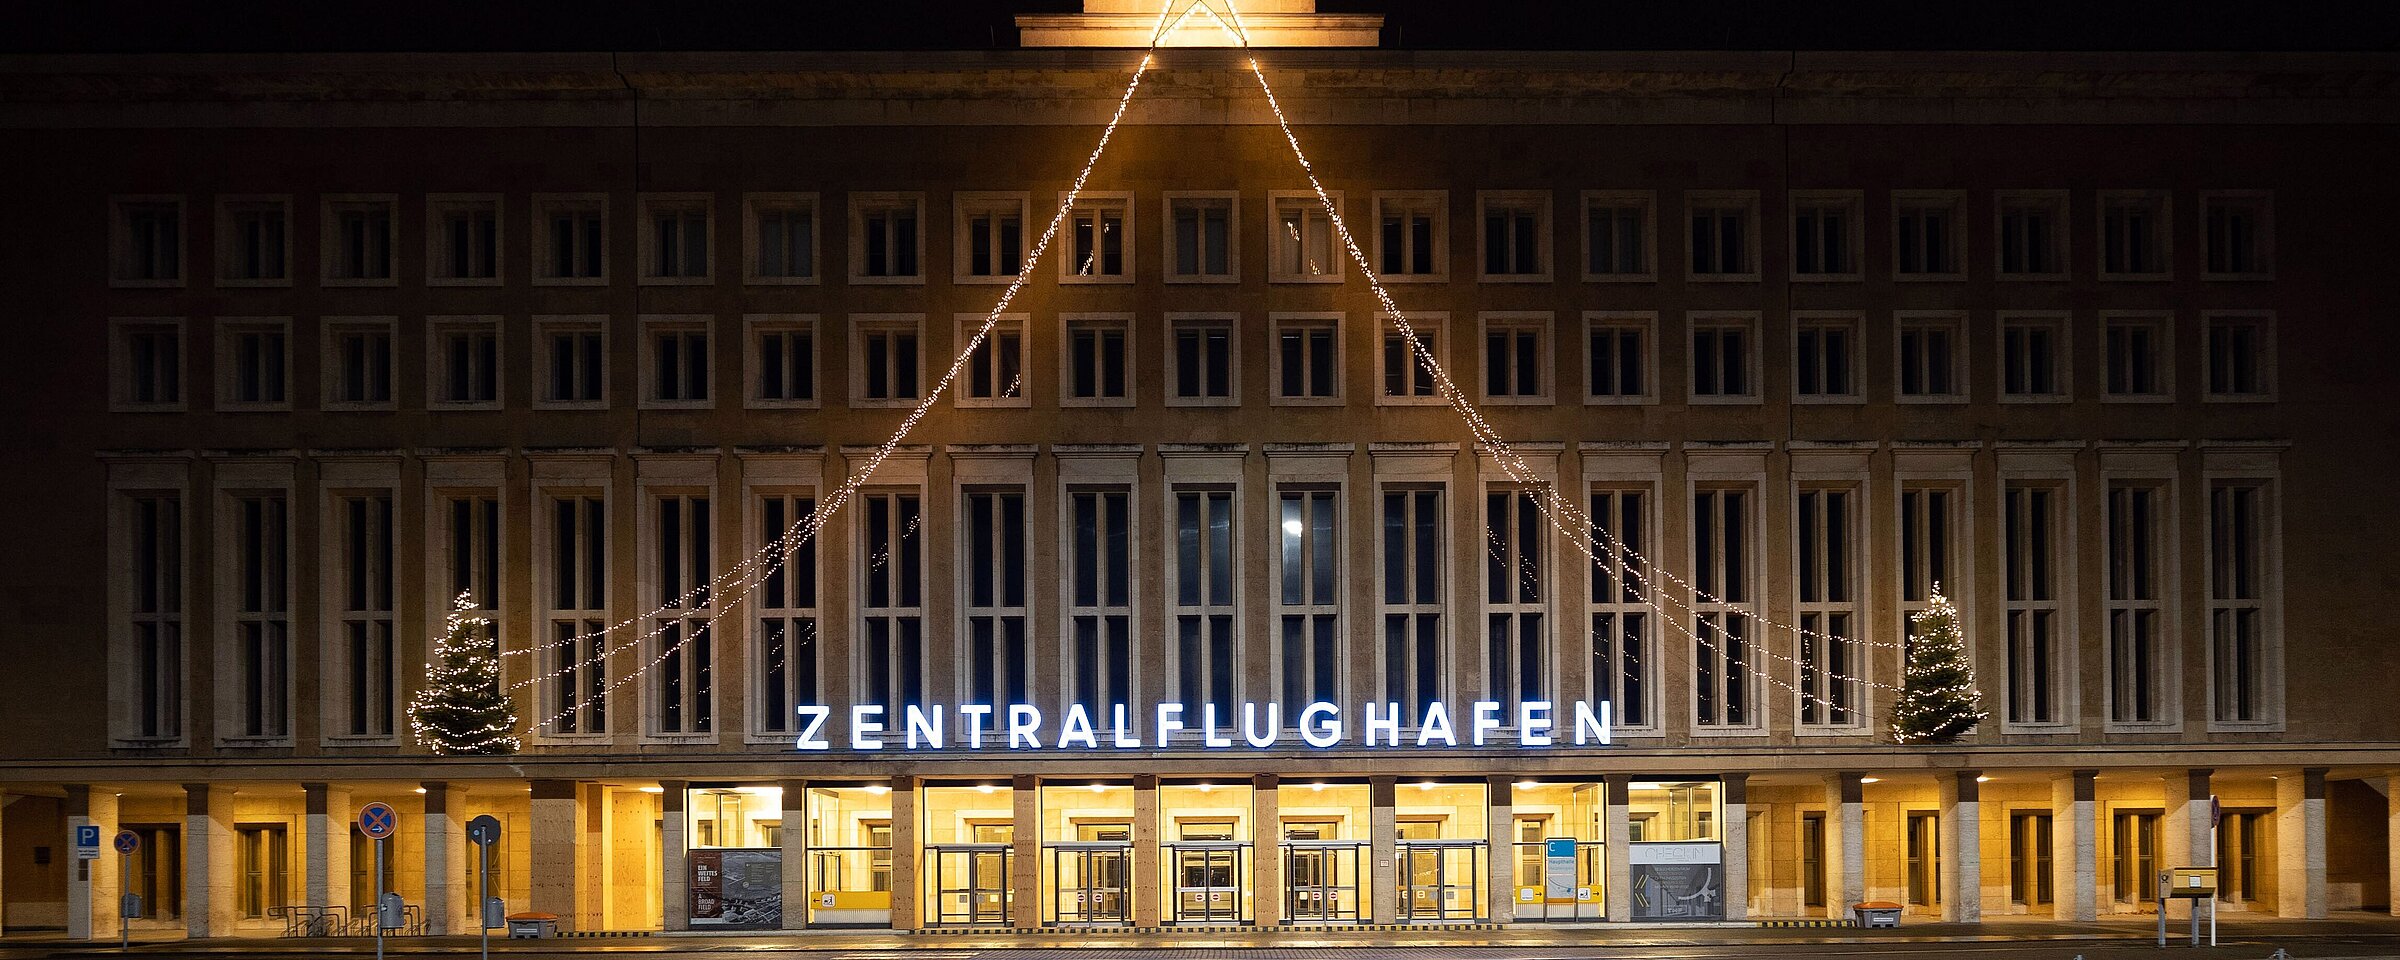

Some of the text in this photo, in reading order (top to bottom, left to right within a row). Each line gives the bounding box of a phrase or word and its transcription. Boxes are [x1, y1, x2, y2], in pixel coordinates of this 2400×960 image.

[797, 700, 1611, 750] ZENTRALFLUGHAFEN
[82, 828, 94, 844] P
[1549, 842, 1556, 852] C
